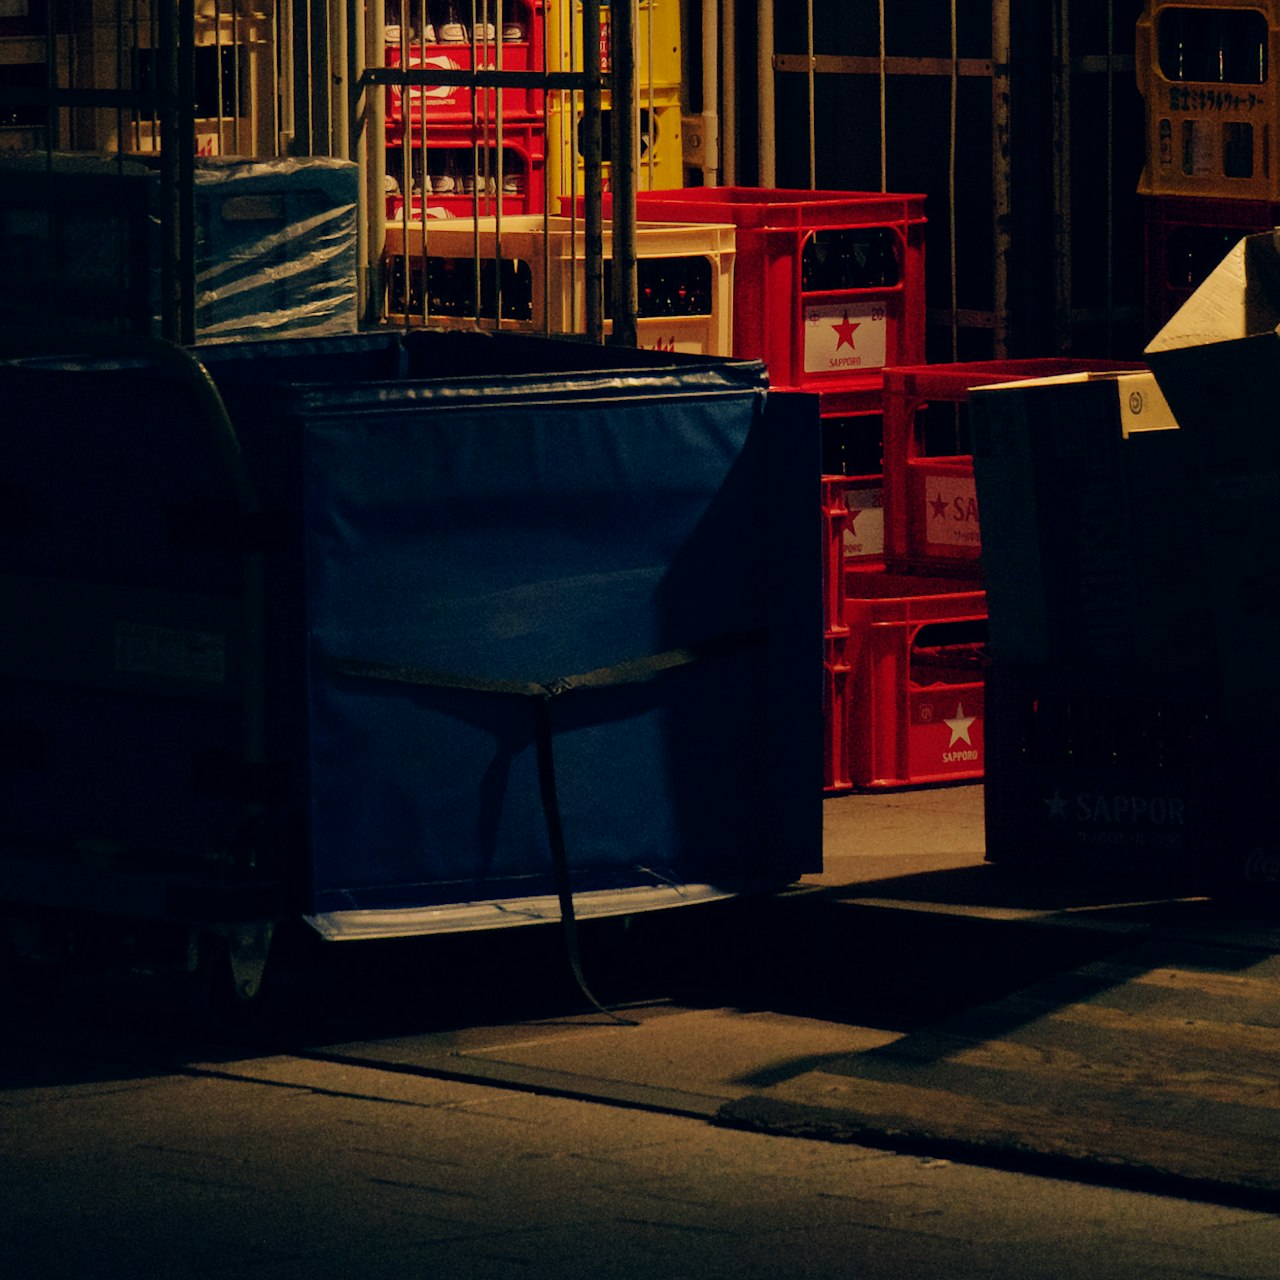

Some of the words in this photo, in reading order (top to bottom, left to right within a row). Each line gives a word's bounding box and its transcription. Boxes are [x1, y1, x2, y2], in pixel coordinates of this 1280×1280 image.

[871, 307, 884, 322] 20
[828, 356, 862, 368] SAPPORO
[942, 749, 978, 763] SAPPORO
[1076, 792, 1186, 826] SAPPOR
